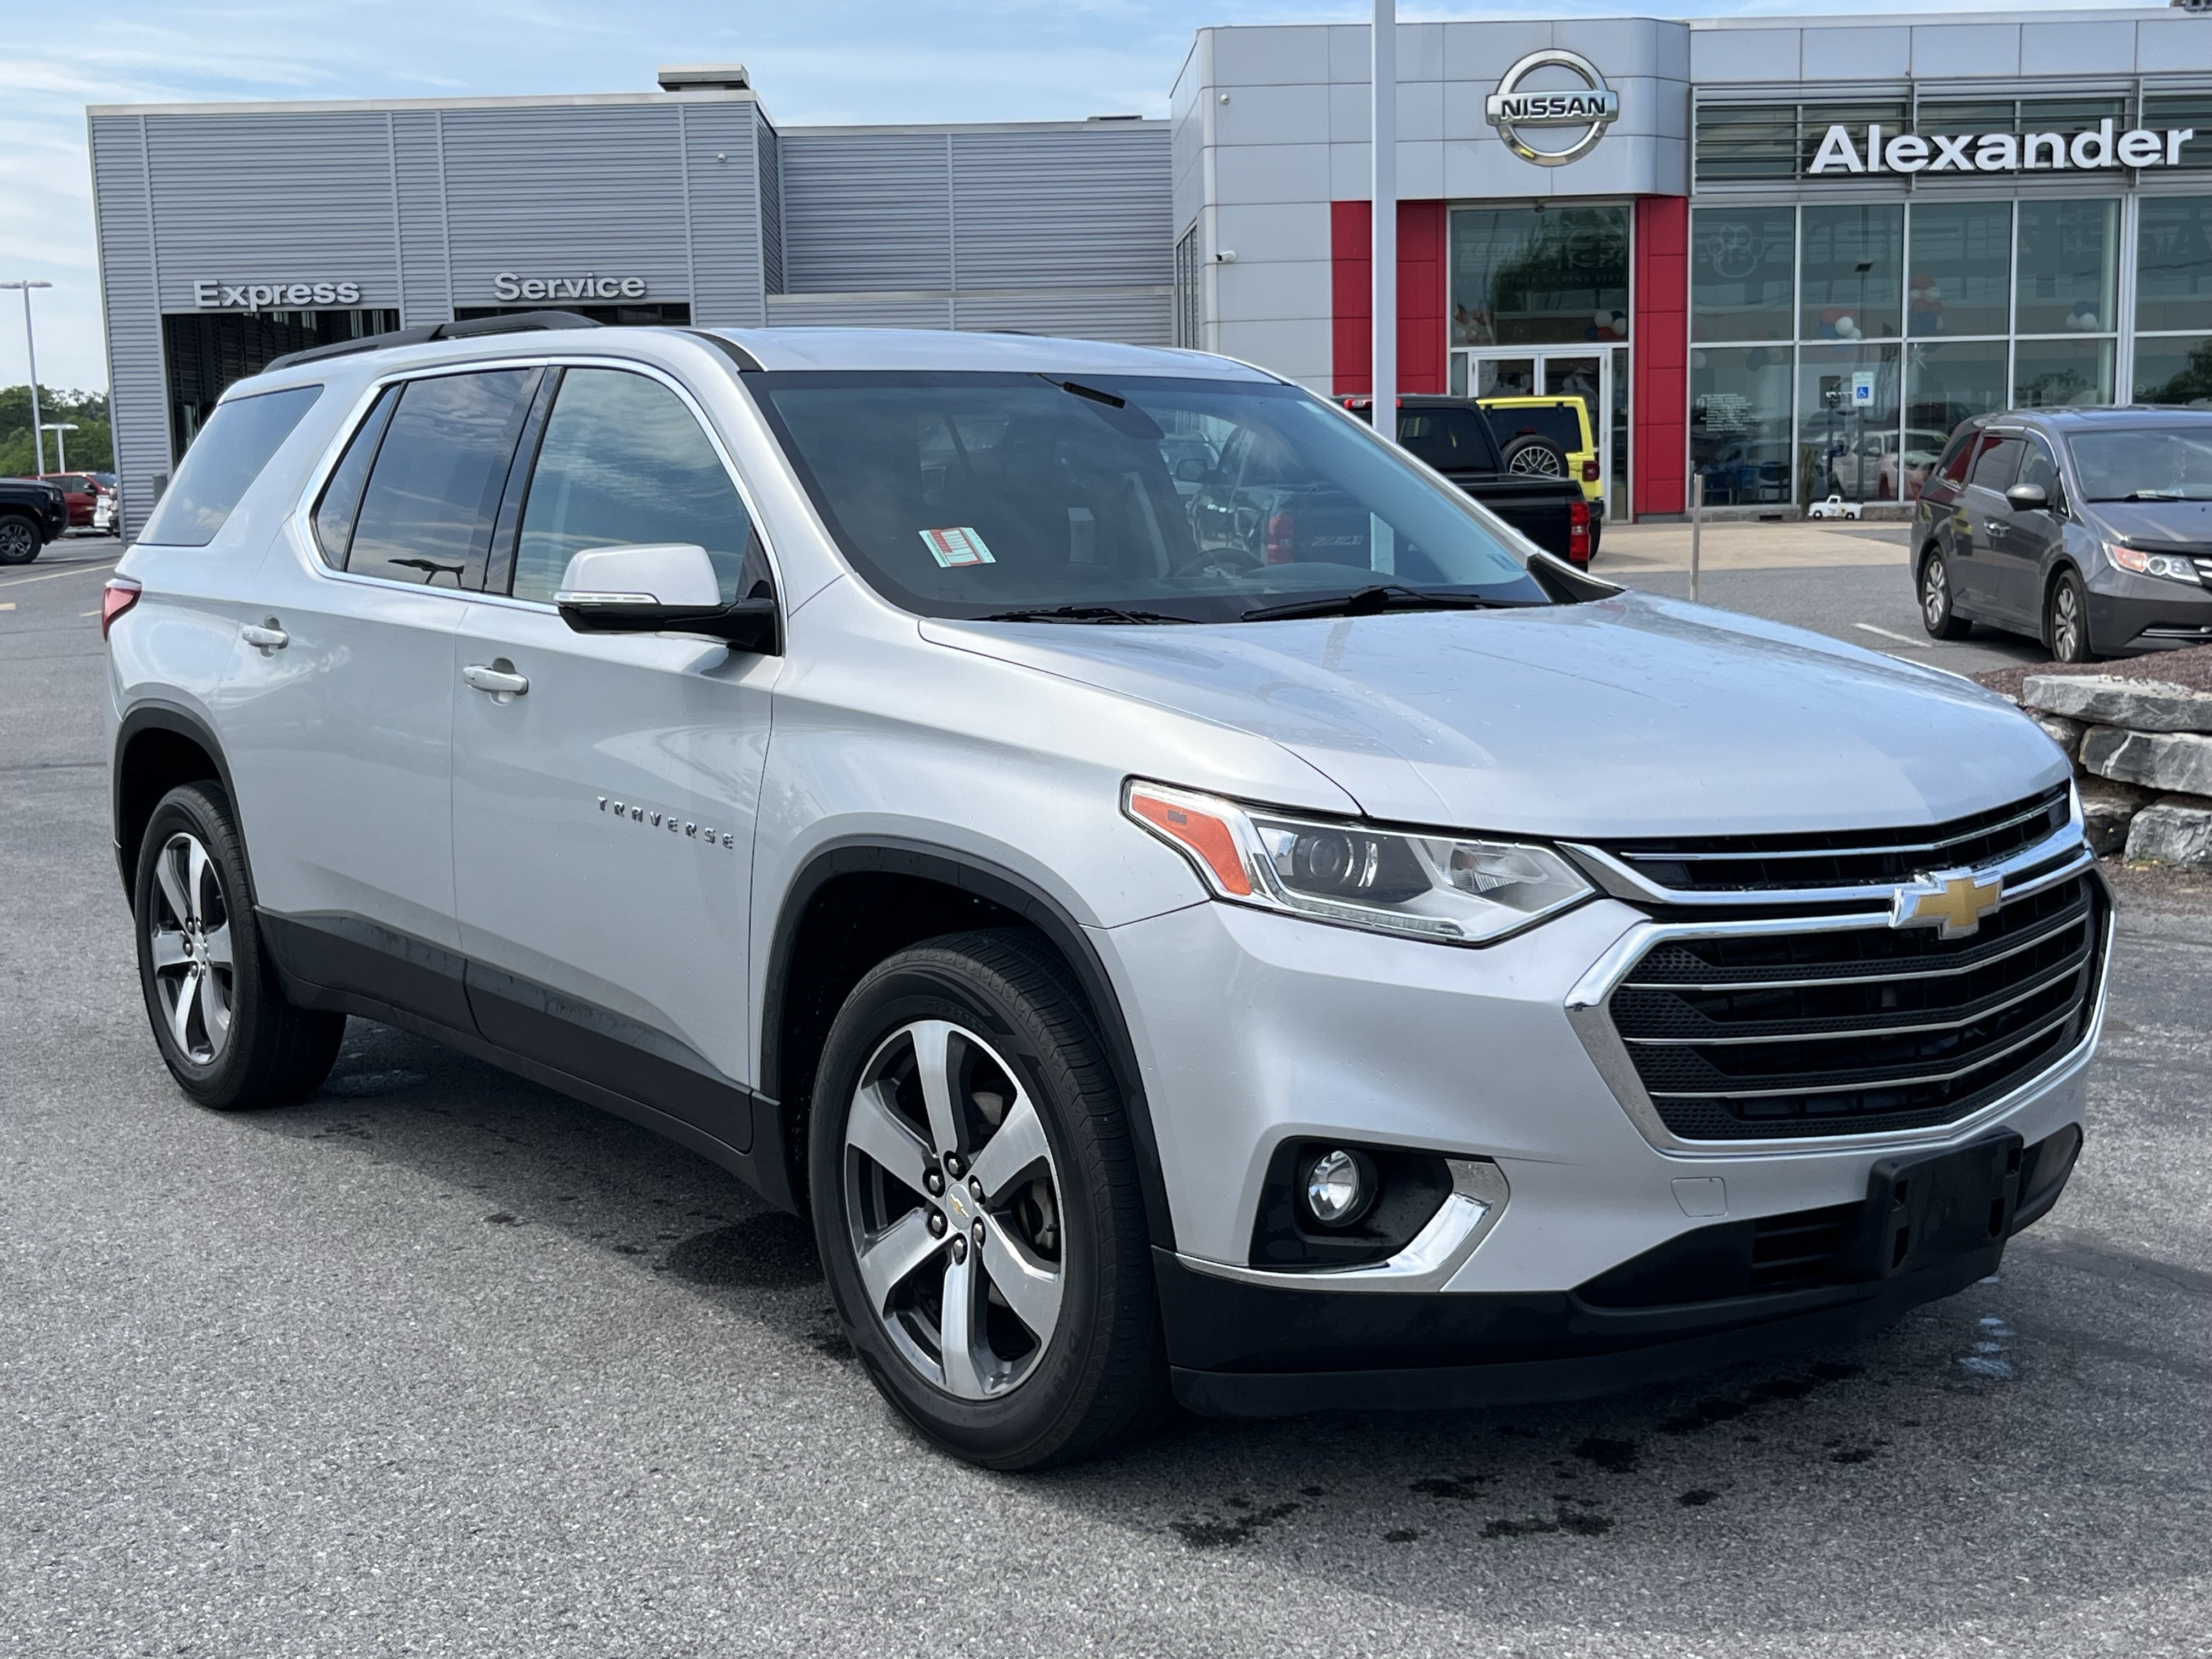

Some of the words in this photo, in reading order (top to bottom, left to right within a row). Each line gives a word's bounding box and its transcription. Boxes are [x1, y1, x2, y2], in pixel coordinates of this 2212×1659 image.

[1500, 97, 1606, 120] NISSAN
[1808, 118, 2193, 174] Alexander
[193, 279, 360, 312] Express
[494, 272, 646, 301] Service
[597, 795, 734, 850] TRAVERSE
